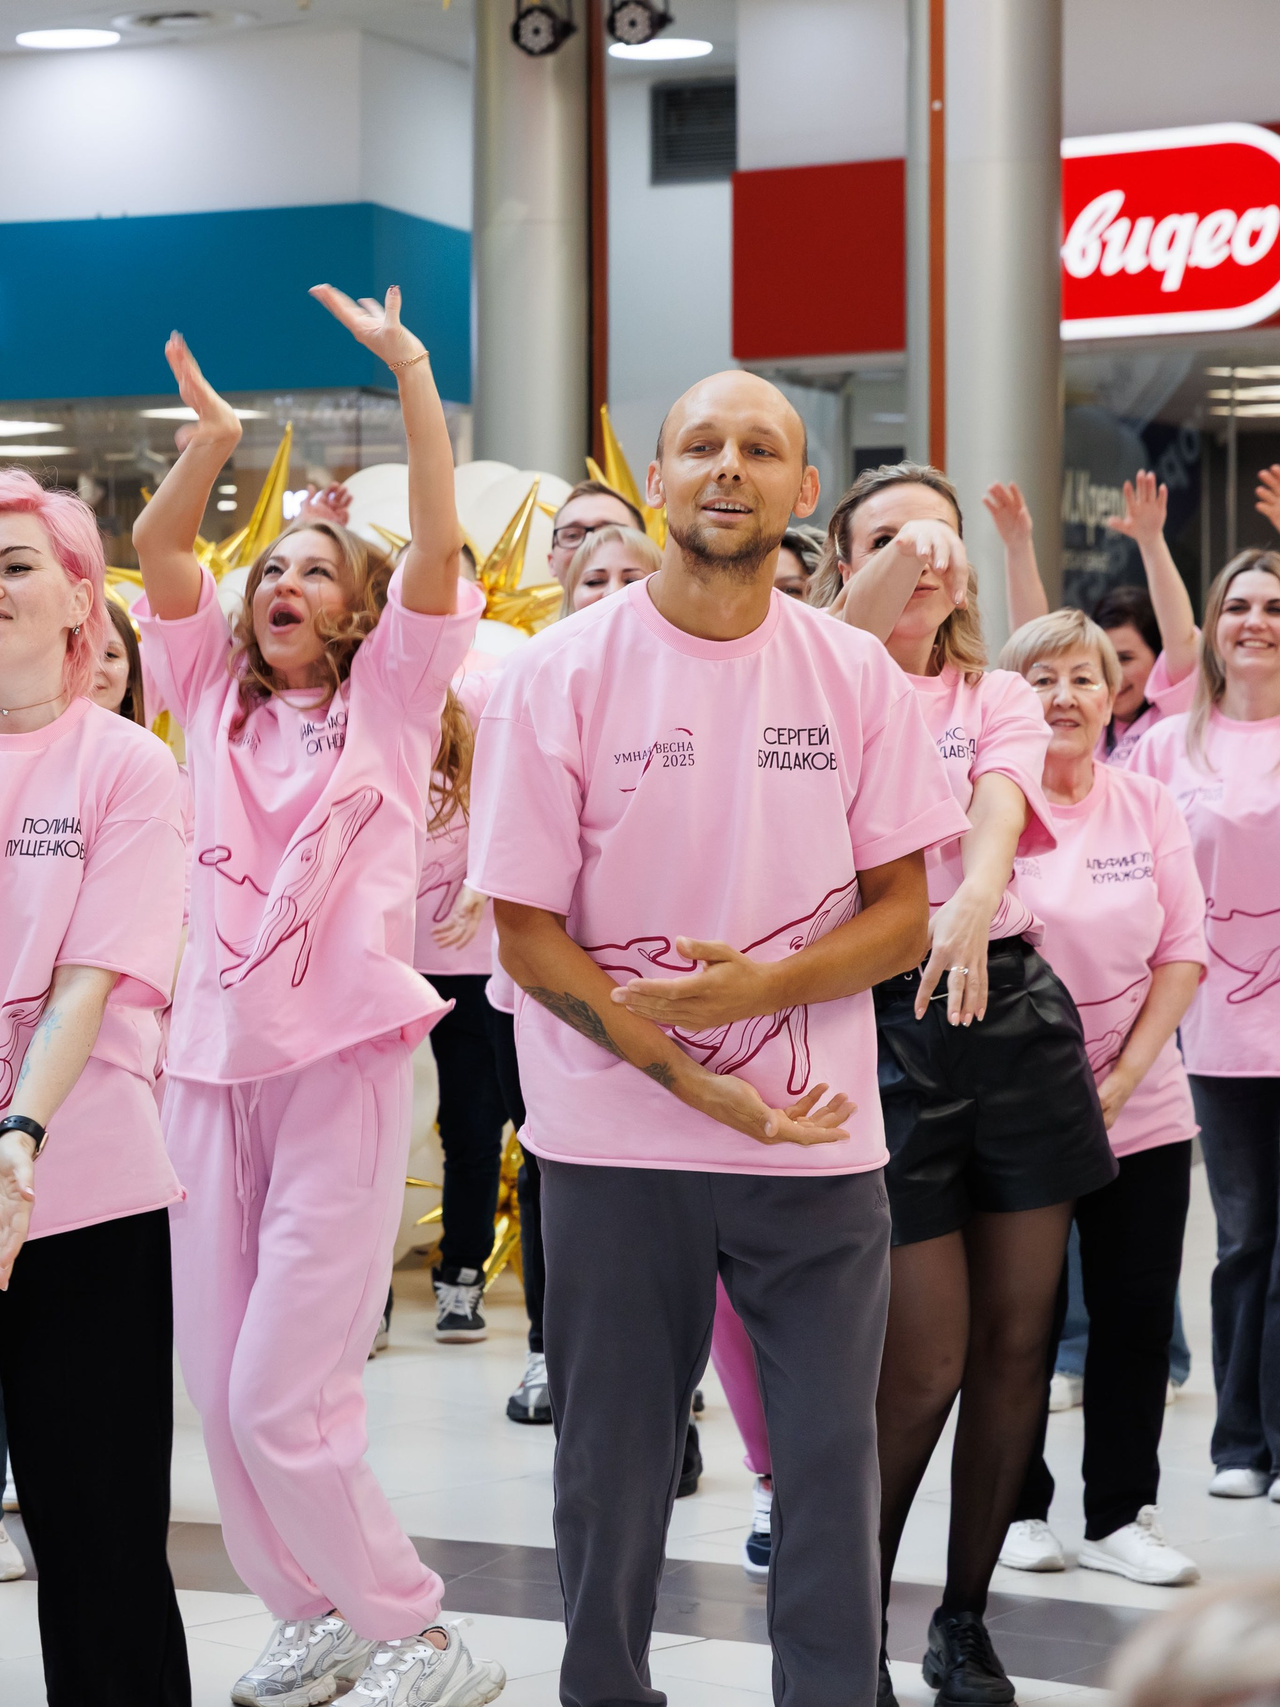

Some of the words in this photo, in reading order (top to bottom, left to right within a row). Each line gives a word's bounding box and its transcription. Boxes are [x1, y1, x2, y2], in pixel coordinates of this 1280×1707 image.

[763, 724, 829, 746] СЕРГЕЙ
[655, 742, 694, 754] ВЕСНА
[662, 753, 695, 768] 2025
[758, 749, 837, 771] БУЛДАКОВ
[22, 817, 82, 835] ПОЛИНА
